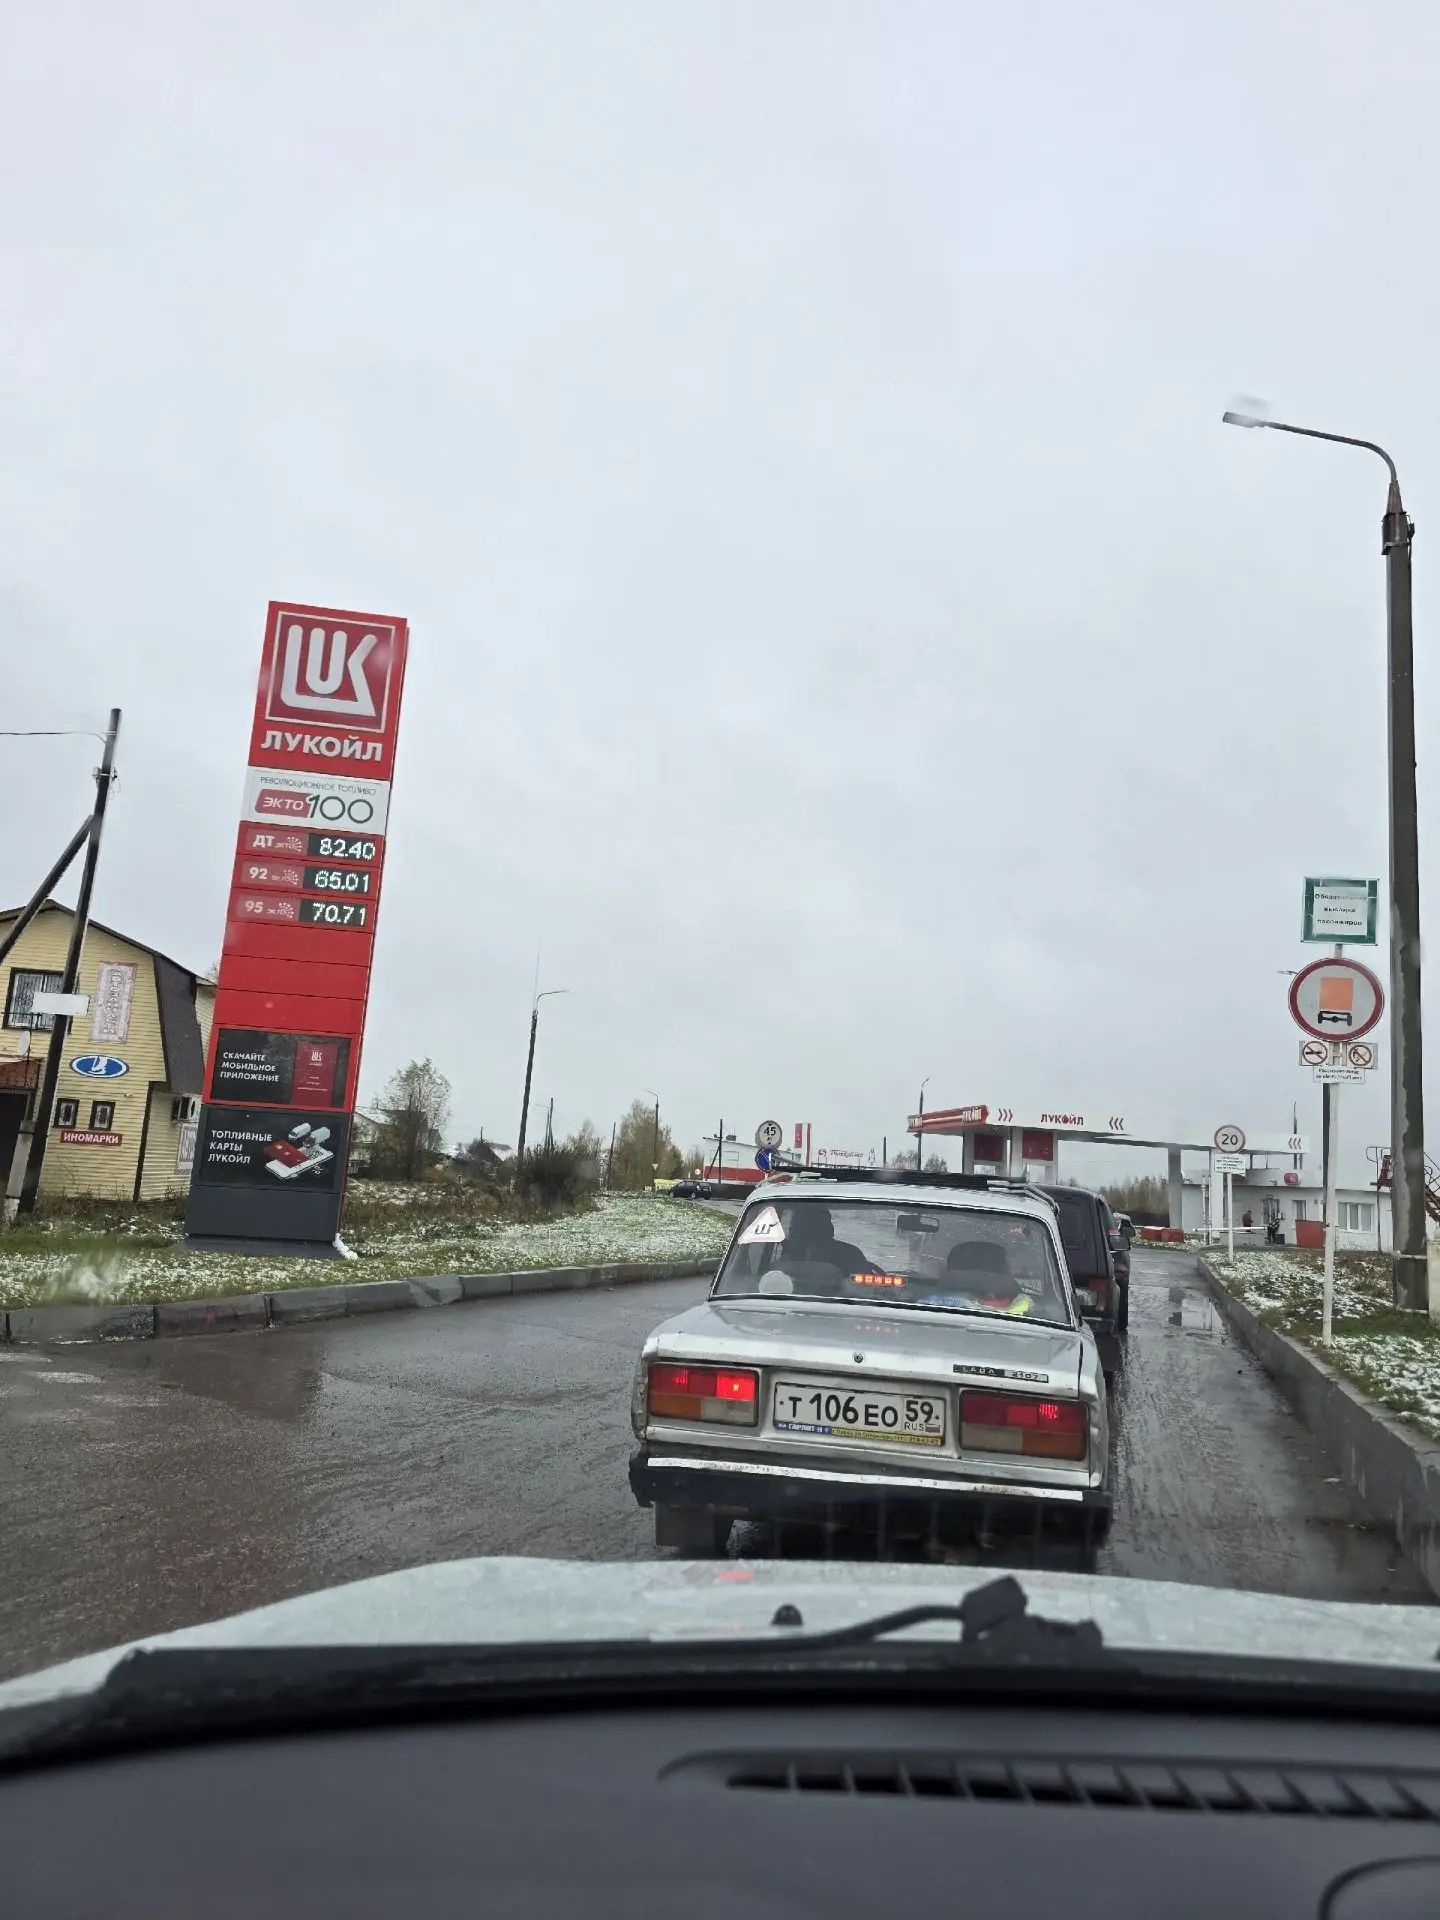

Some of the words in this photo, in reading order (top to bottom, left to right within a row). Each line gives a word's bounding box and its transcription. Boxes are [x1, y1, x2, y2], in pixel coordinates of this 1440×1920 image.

[261, 730, 383, 762] ЛУКОЙЛ
[260, 776, 336, 792] РЕВОЛЮЦИОННОЕ
[338, 784, 377, 796] ТОПЛИВО
[262, 796, 304, 811] ЭКТО
[307, 793, 375, 824] 100
[252, 833, 275, 849] ДТ
[319, 837, 376, 861] 82.40
[249, 866, 268, 880] 92
[314, 869, 370, 893] 65.01
[244, 900, 264, 914] 95
[312, 901, 367, 926] 70.71
[222, 1051, 266, 1062] СКАЧАЙТЕ
[221, 1061, 277, 1072] МОБИЛЬНОЕ
[219, 1071, 280, 1083] ПРИЛОЖЕНИЕ
[1040, 1113, 1084, 1126] ЛУКОЙЛ
[63, 1131, 120, 1145] ИНОМАРКИ
[211, 1129, 273, 1142] ТОПЛИВНЫЕ
[1220, 1133, 1239, 1147] 20
[209, 1142, 243, 1151] КАРТЫ
[207, 1152, 251, 1164] ЛУКОЙЛ
[904, 1423, 925, 1432] RUS
